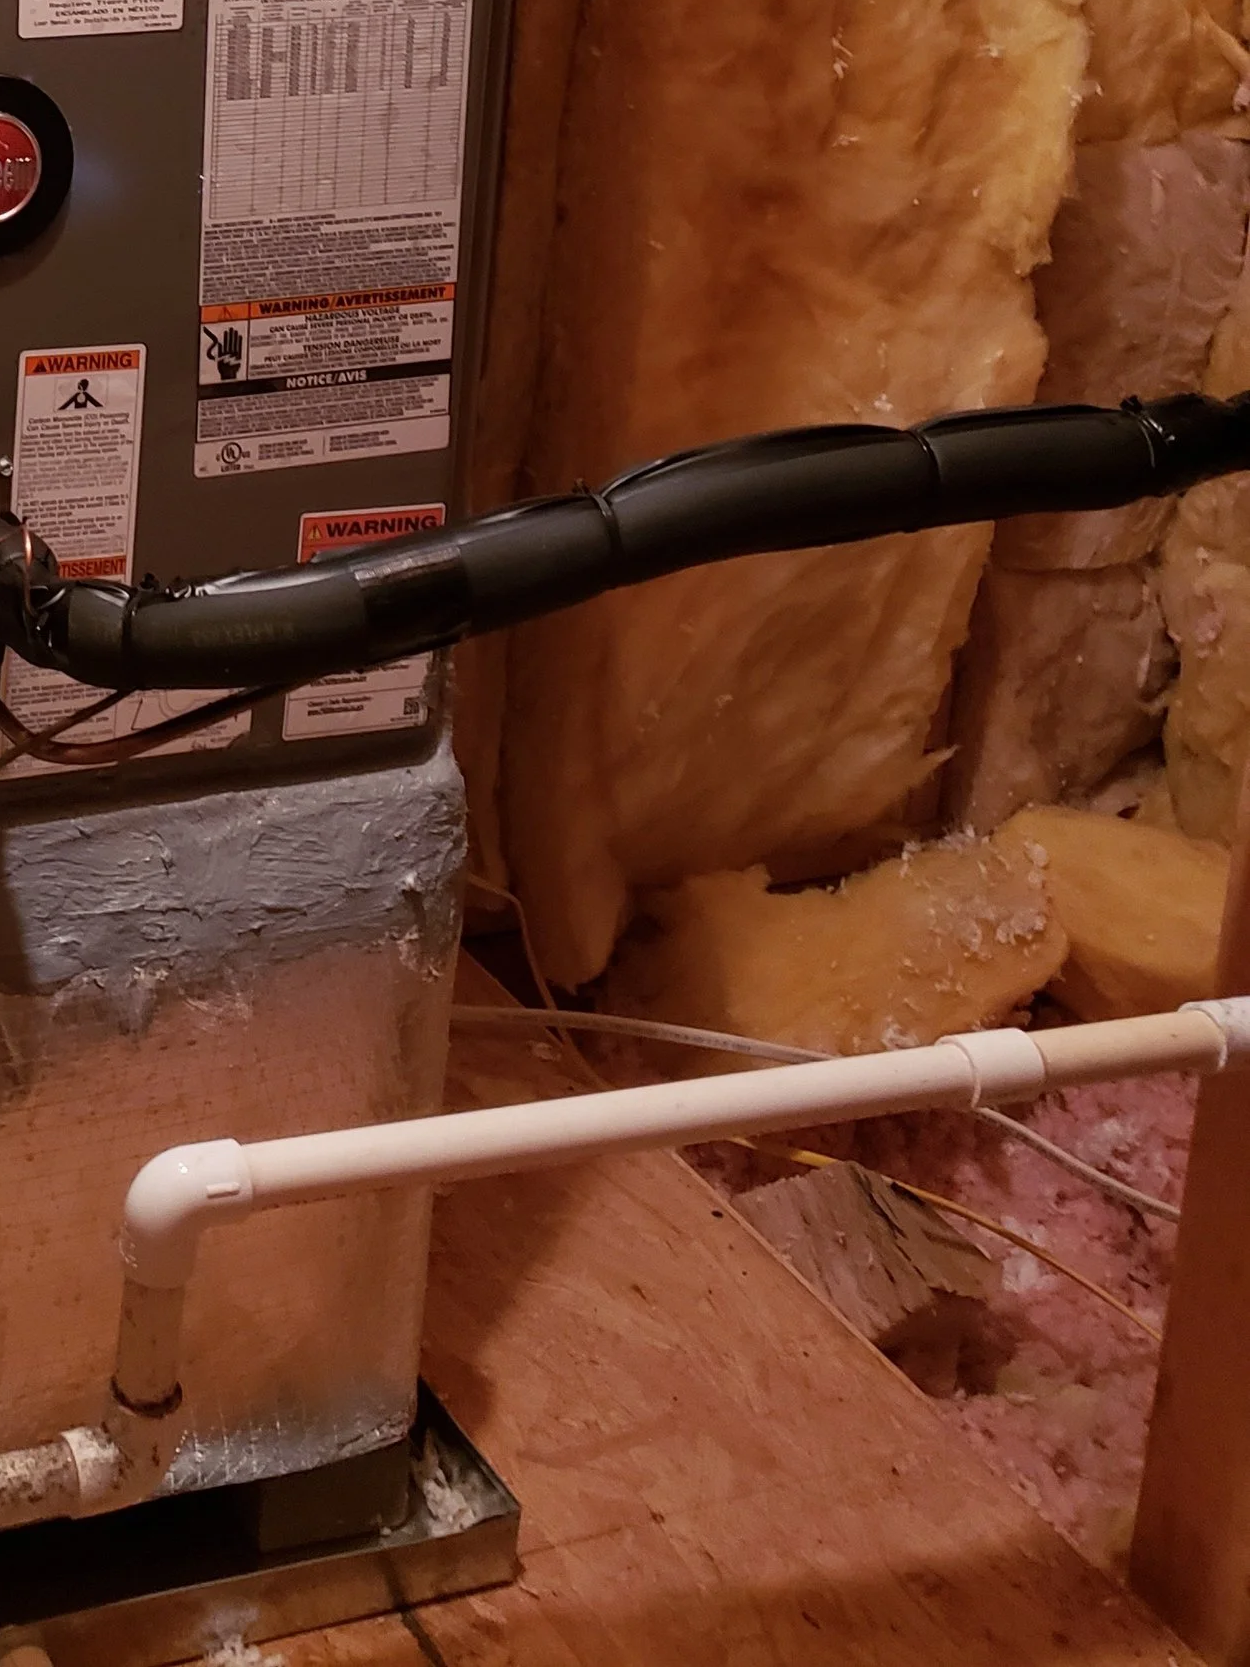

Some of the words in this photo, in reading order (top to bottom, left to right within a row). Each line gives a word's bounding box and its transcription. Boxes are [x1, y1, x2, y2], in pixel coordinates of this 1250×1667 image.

[305, 310, 360, 321] HAZARDOUS
[362, 307, 400, 316] VOLTAGE
[269, 325, 285, 333] CAN
[286, 323, 308, 331] CAUSE
[310, 322, 335, 330] SEVERE
[336, 318, 371, 327] PERSONAL
[372, 316, 397, 325] INJURY
[264, 355, 281, 363] PEUT
[282, 353, 309, 361] CAUSER
[310, 351, 323, 359] DES
[354, 344, 399, 355] CORPORELLES
[422, 339, 441, 347] MORT
[302, 342, 342, 352] TENSION
[343, 336, 399, 349] DANGEREUSE
[48, 352, 132, 373] WARNING
[286, 370, 367, 388] NOTICE/AVIS
[326, 515, 437, 538] WARNING
[61, 559, 126, 578] TISSEMENT
